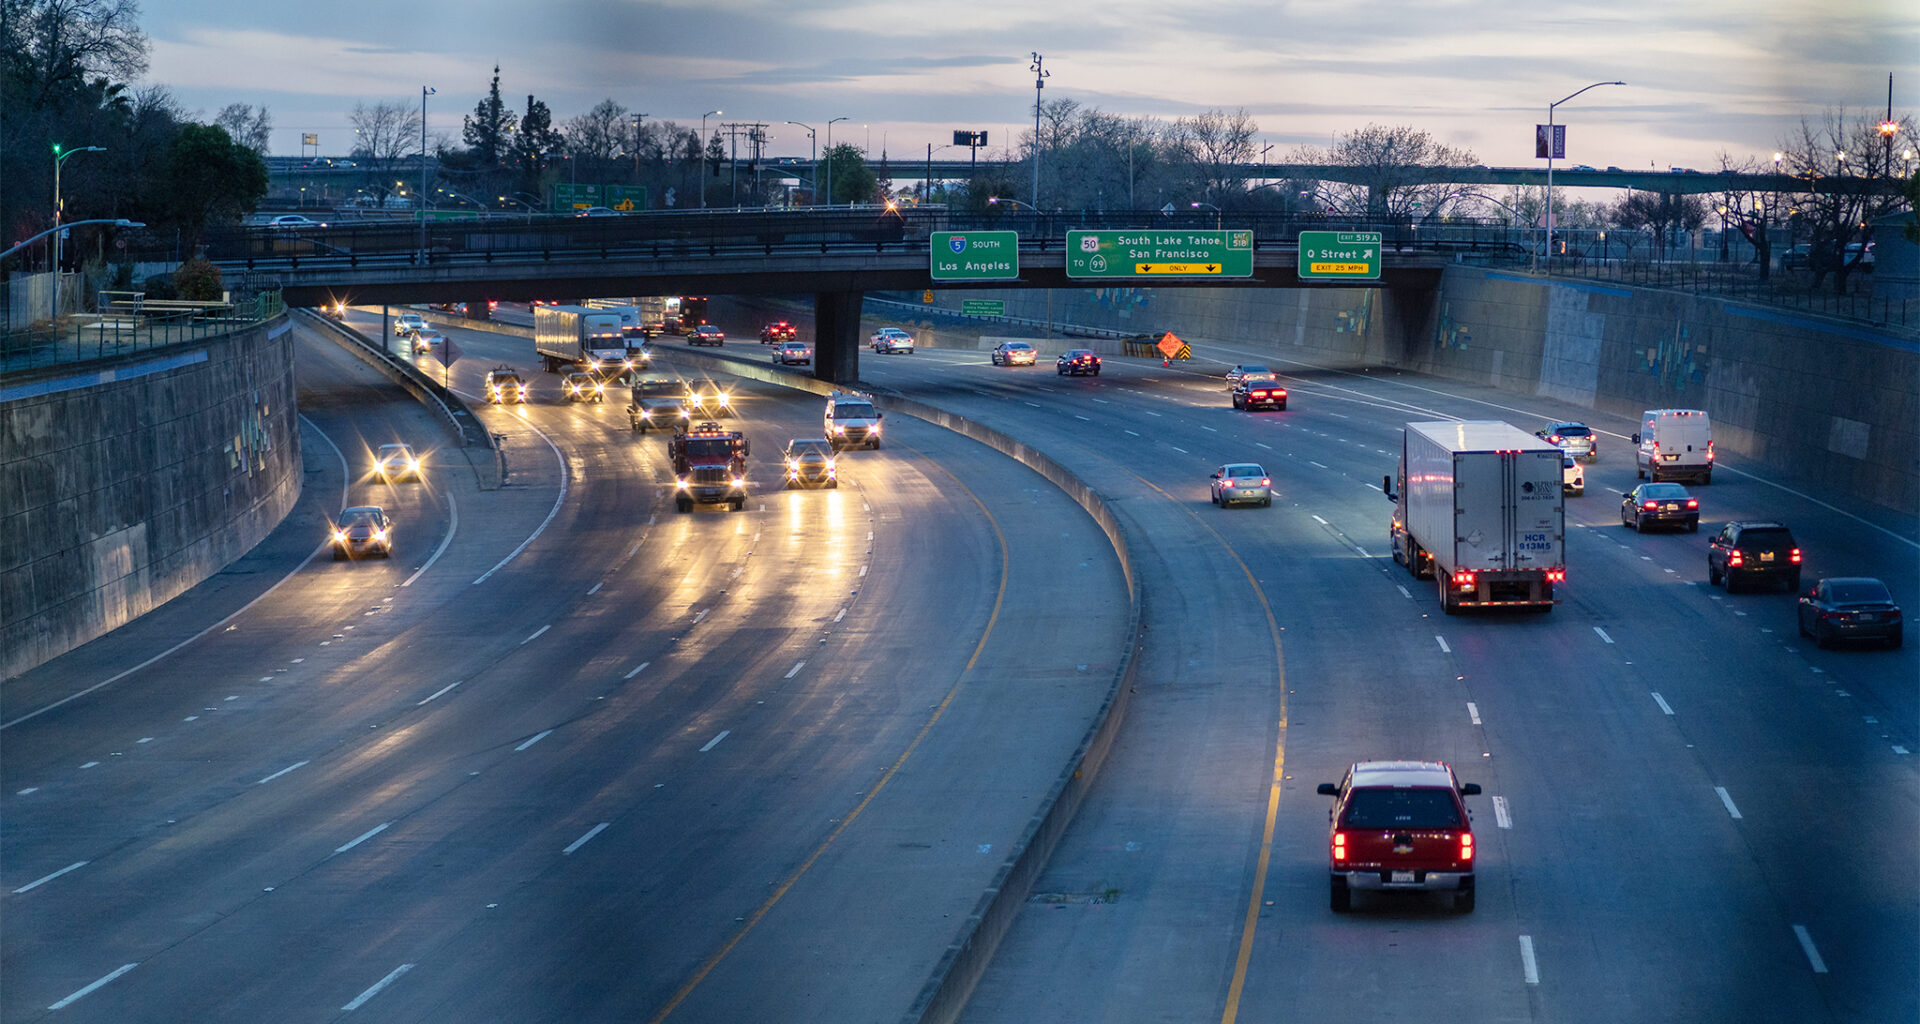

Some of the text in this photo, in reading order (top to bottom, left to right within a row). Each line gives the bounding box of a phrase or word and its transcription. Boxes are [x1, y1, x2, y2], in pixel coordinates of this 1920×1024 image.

[1084, 240, 1097, 249] 50
[1118, 235, 1220, 245] South Lake Tahoe
[1233, 239, 1247, 247] 518
[955, 241, 961, 250] 5
[1129, 248, 1209, 258] San Francisco
[1307, 249, 1357, 259] Q Street
[939, 261, 1010, 273] Los Angeles
[1092, 260, 1104, 269] 99
[1524, 534, 1546, 542] HCR
[1519, 542, 1551, 550] 913M5
